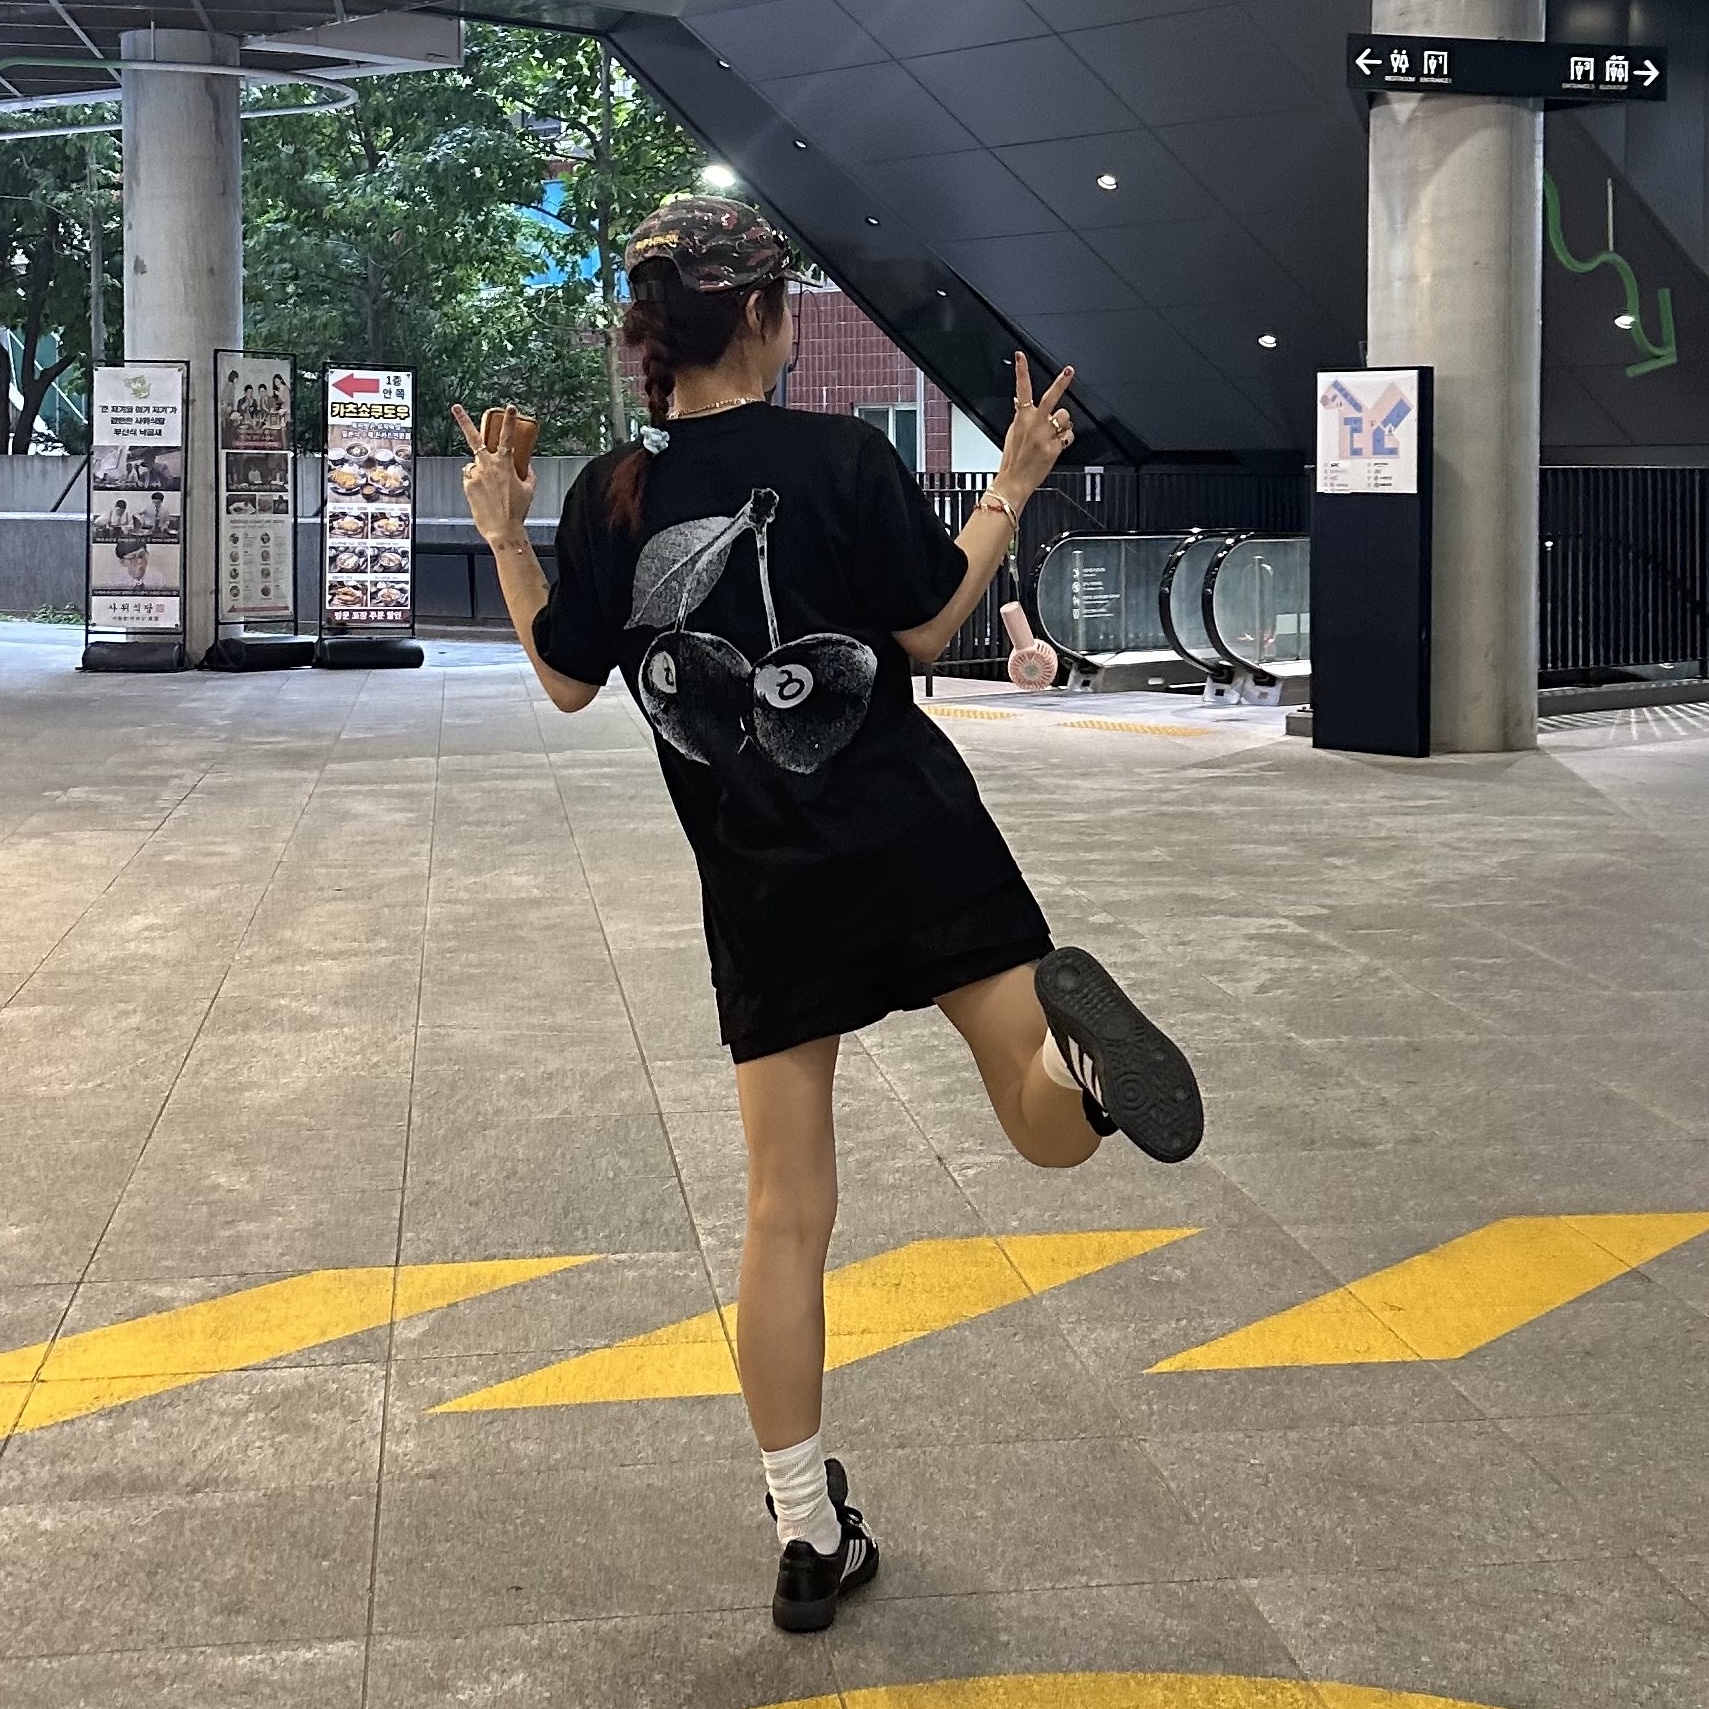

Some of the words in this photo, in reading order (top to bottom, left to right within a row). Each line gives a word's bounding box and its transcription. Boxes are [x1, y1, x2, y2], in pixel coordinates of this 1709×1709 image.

[386, 375, 402, 387] 1층
[331, 402, 410, 420] 카츠쇼쿠도우
[107, 603, 153, 614] 사위식당
